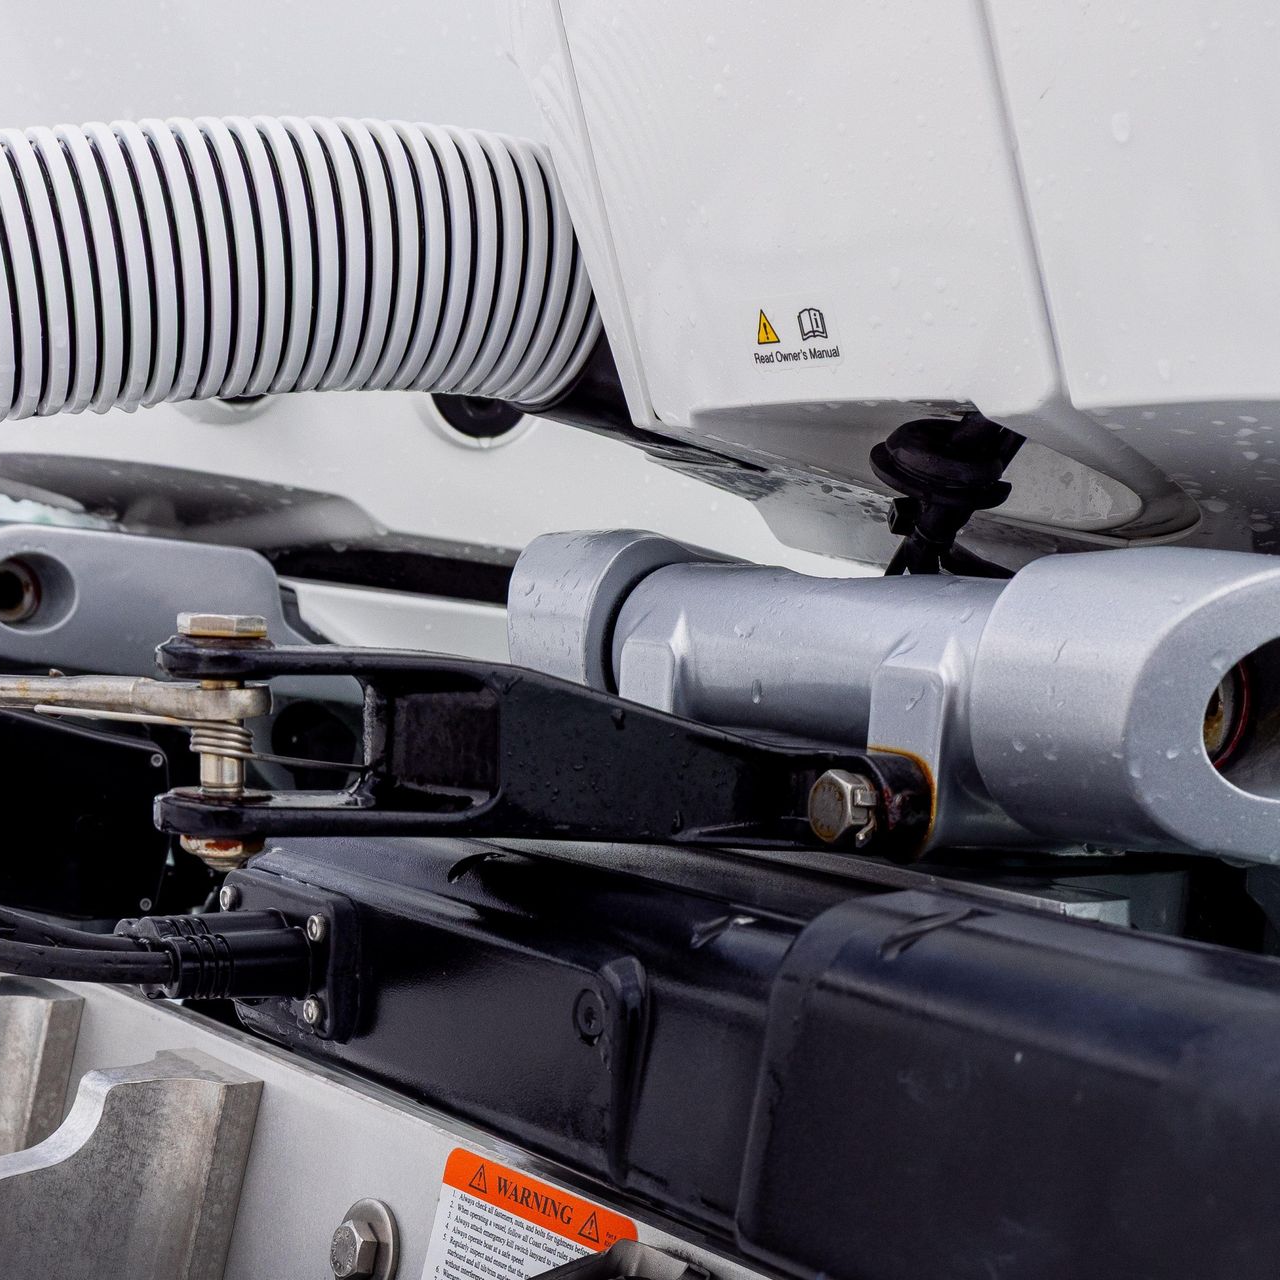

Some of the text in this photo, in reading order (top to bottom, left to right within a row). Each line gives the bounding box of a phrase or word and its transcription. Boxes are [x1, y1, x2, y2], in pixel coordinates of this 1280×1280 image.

[754, 346, 840, 364] Read Owner's Manual
[459, 1193, 475, 1206] Always
[475, 1200, 487, 1212] check
[534, 1226, 546, 1238] bolts
[497, 1175, 574, 1225] WARNING
[451, 1226, 468, 1239] Always
[467, 1234, 483, 1246] operate
[511, 1255, 525, 1266] speed.
[454, 1215, 470, 1228] Always
[470, 1223, 483, 1234] attach
[483, 1230, 506, 1246] emergency
[514, 1244, 529, 1256] switch
[529, 1249, 547, 1264] lanyard
[457, 1203, 469, 1215] When
[469, 1211, 489, 1226] operating
[507, 1226, 521, 1239] follow
[528, 1236, 542, 1249] Coast
[542, 1242, 557, 1256] Guard
[445, 1259, 460, 1271] without
[449, 1236, 469, 1253] Regularly
[469, 1245, 485, 1259] inspect
[493, 1259, 507, 1270] ensure
